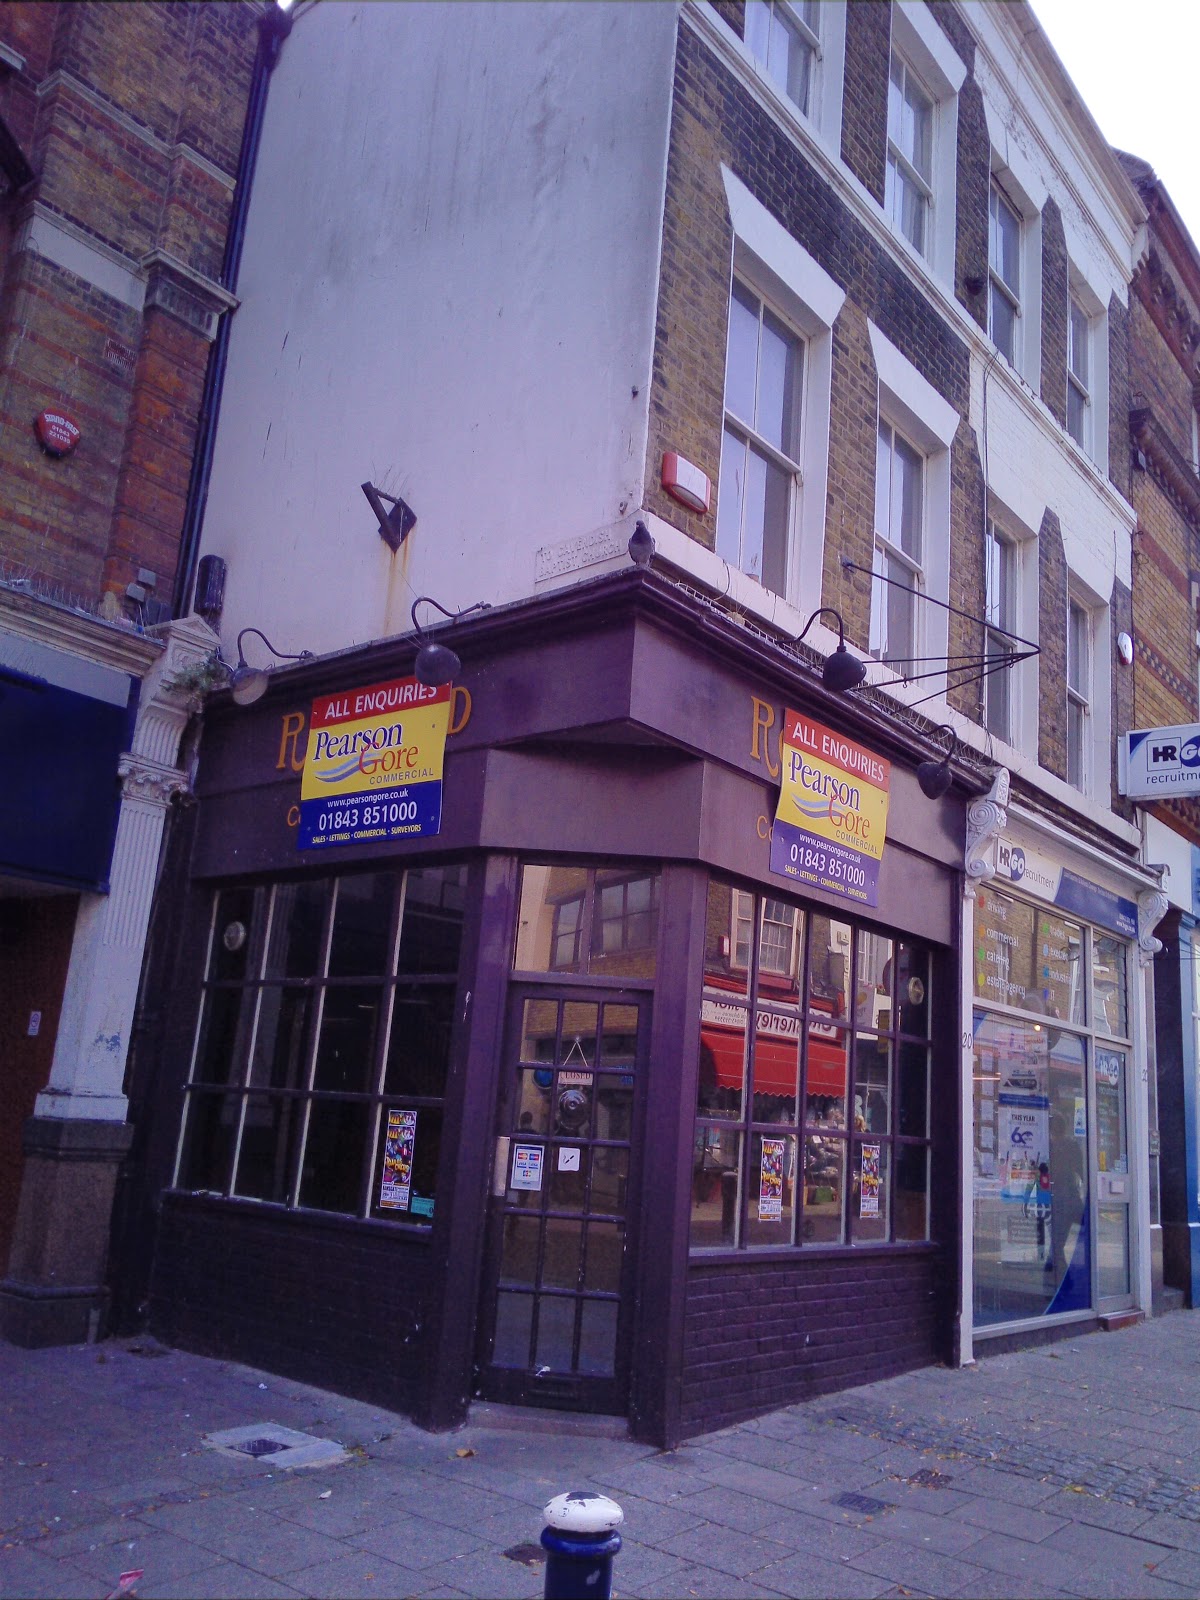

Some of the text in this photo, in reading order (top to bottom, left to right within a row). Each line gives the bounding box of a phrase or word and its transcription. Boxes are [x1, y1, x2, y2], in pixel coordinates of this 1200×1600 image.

[540, 531, 610, 564] TO CAVENDISH
[582, 542, 620, 563] CHURCH
[324, 700, 350, 720] ALL
[355, 685, 438, 714] ENQUIRIES
[313, 723, 402, 762] Pearson
[792, 721, 818, 750] ALL
[822, 735, 884, 782] ENQUIRIES
[359, 742, 419, 775] Gore
[369, 769, 434, 785] COMMERCIAL
[789, 750, 860, 811] Pearson
[1146, 771, 1200, 784] recruitm
[327, 788, 409, 808] www.pearsongore.co.uk
[318, 809, 358, 831] 01843
[363, 801, 418, 825] 851000
[829, 794, 871, 839] Gore
[312, 824, 422, 844] SALES LETTINGS COMMERCIAL SURVEYORS
[836, 830, 878, 855] COMMERCIAL
[800, 834, 862, 864] www.pearsongore.co.uk
[790, 843, 865, 886] 01843 851000
[1024, 868, 1055, 890] recruitment
[986, 928, 1019, 947] commercial
[986, 950, 1010, 971] catering
[561, 1071, 591, 1080] CLOSED
